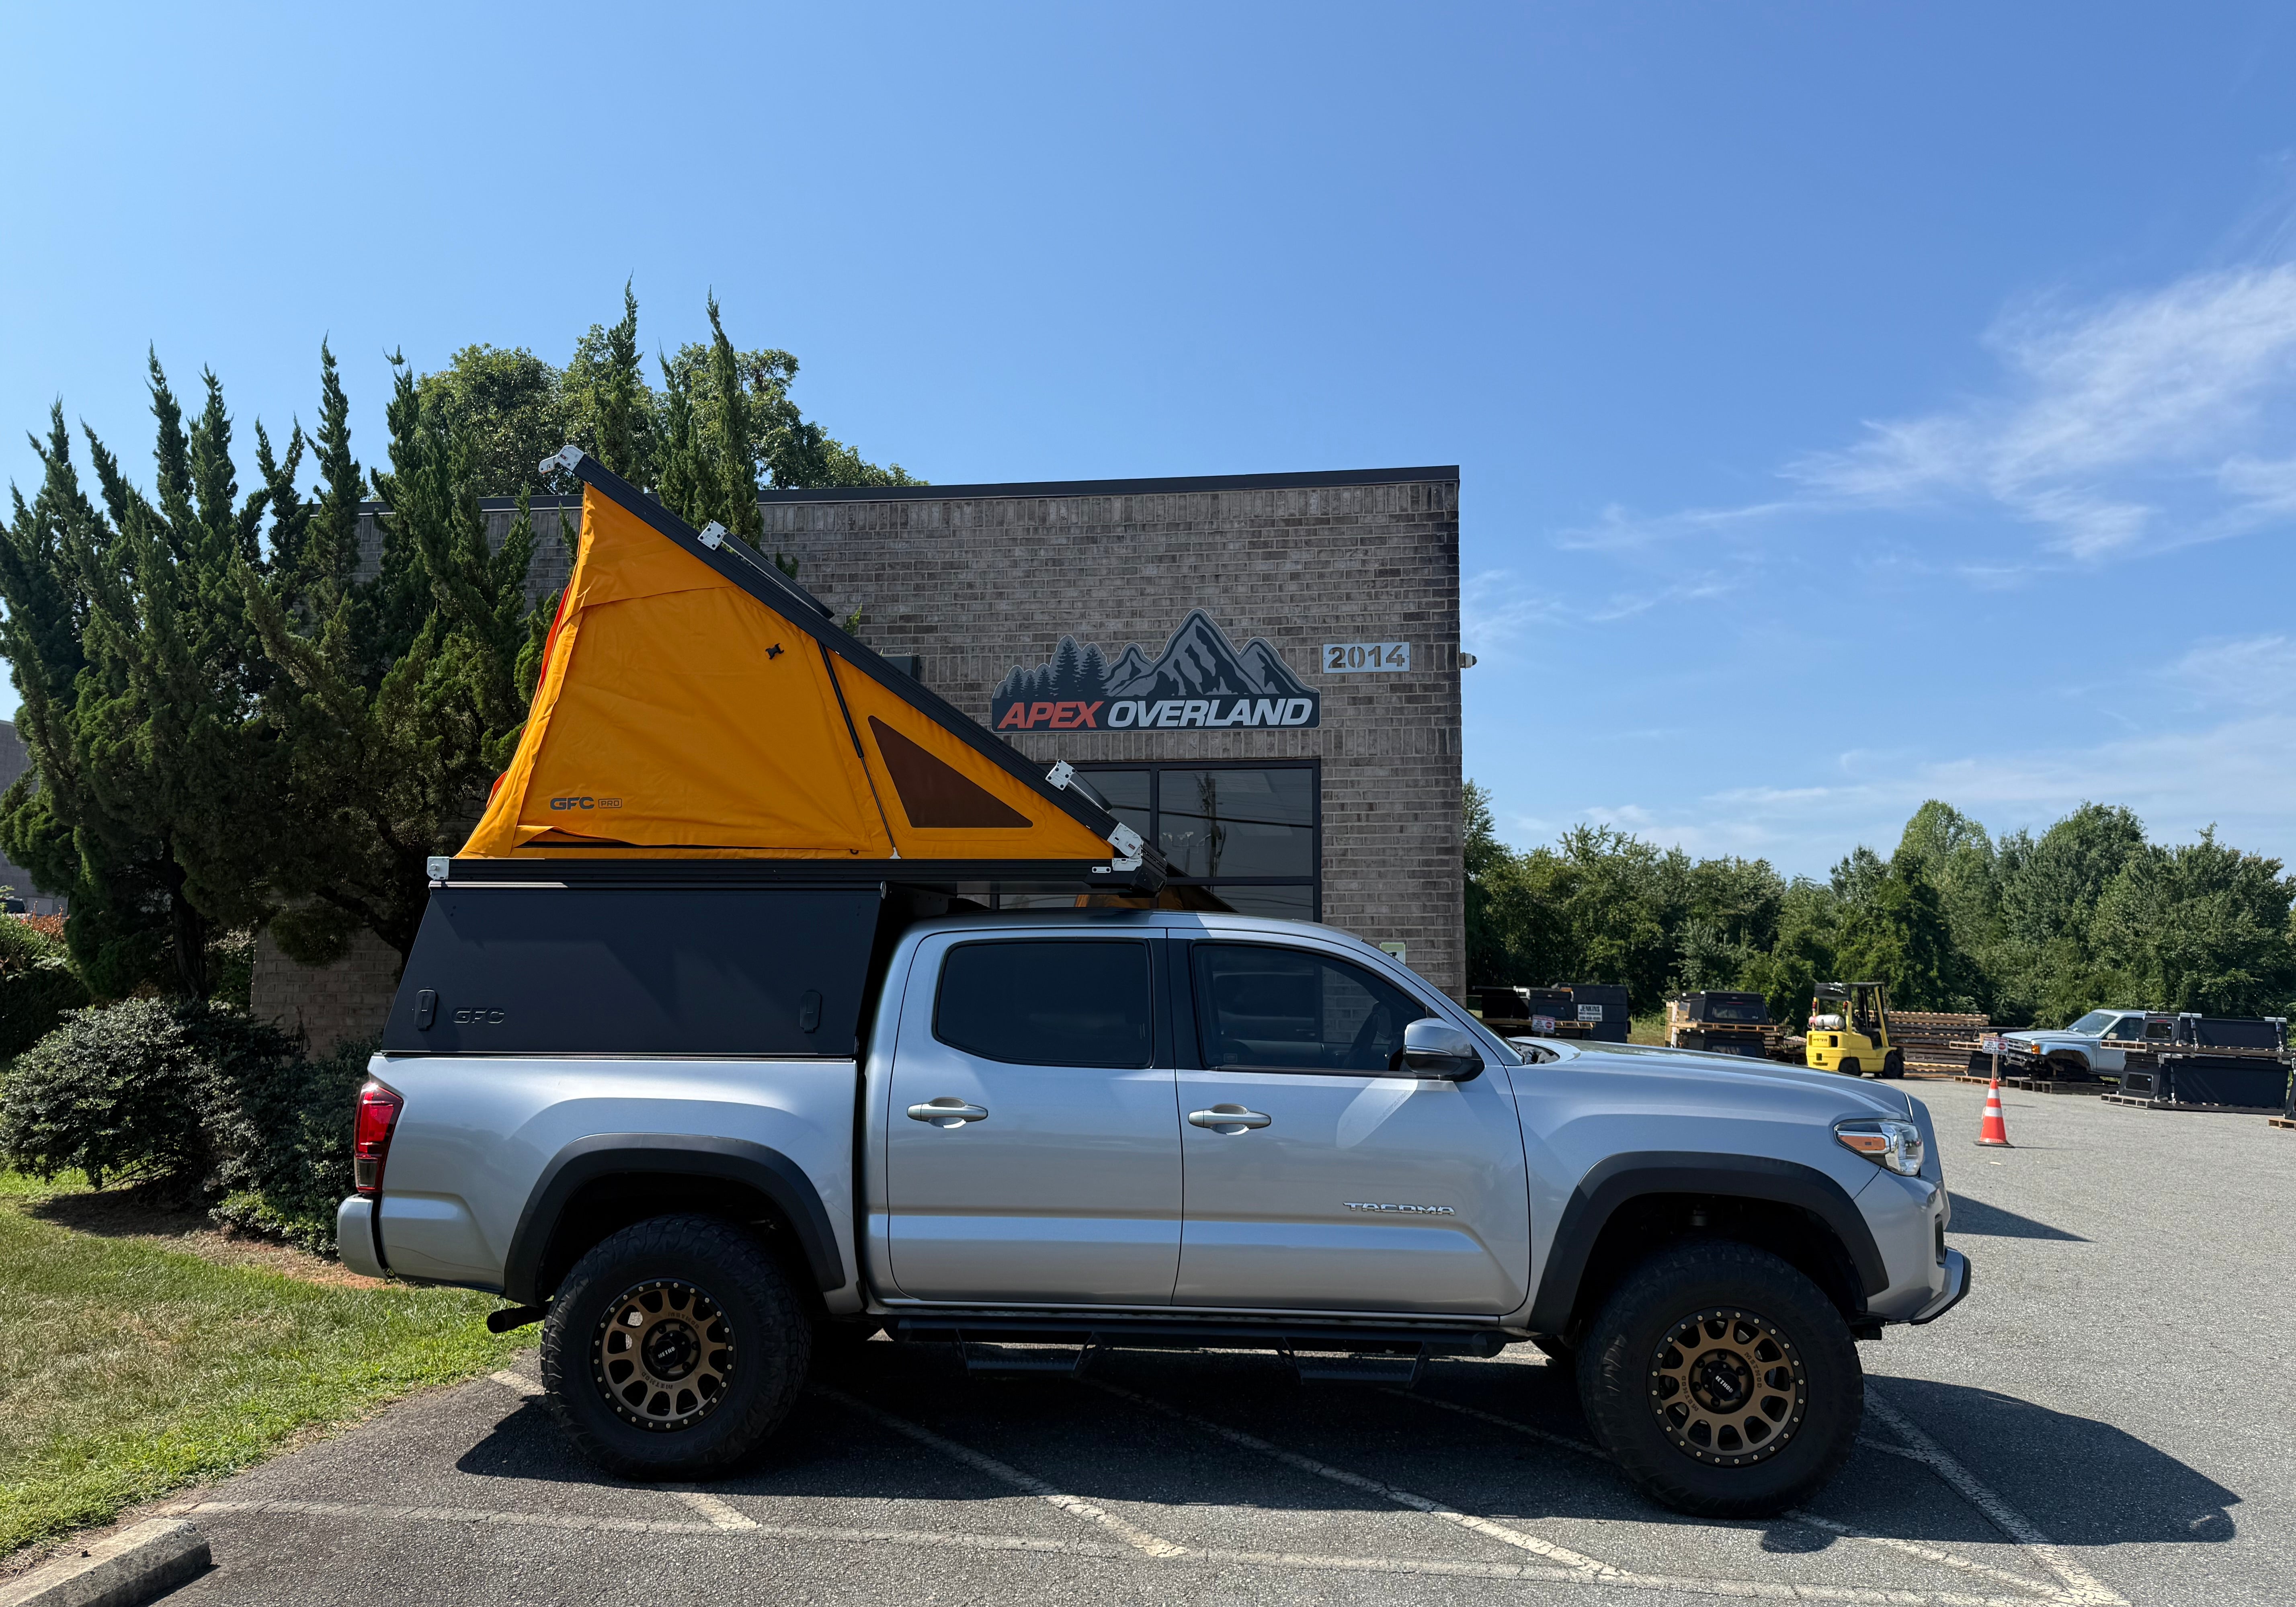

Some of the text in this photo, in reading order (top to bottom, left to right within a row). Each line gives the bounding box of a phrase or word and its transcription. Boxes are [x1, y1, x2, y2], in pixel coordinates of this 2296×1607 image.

[1328, 645, 1405, 668] 2014
[996, 698, 1312, 729] APEX OVERLAND
[550, 797, 594, 810] GFC
[451, 1007, 505, 1024] GFC
[1343, 1202, 1456, 1216] TACOMA
[668, 1312, 699, 1329] METHOD
[1744, 1352, 1762, 1389] METHOD
[641, 1371, 673, 1390] METHOD
[1681, 1375, 1699, 1412] METHOD
